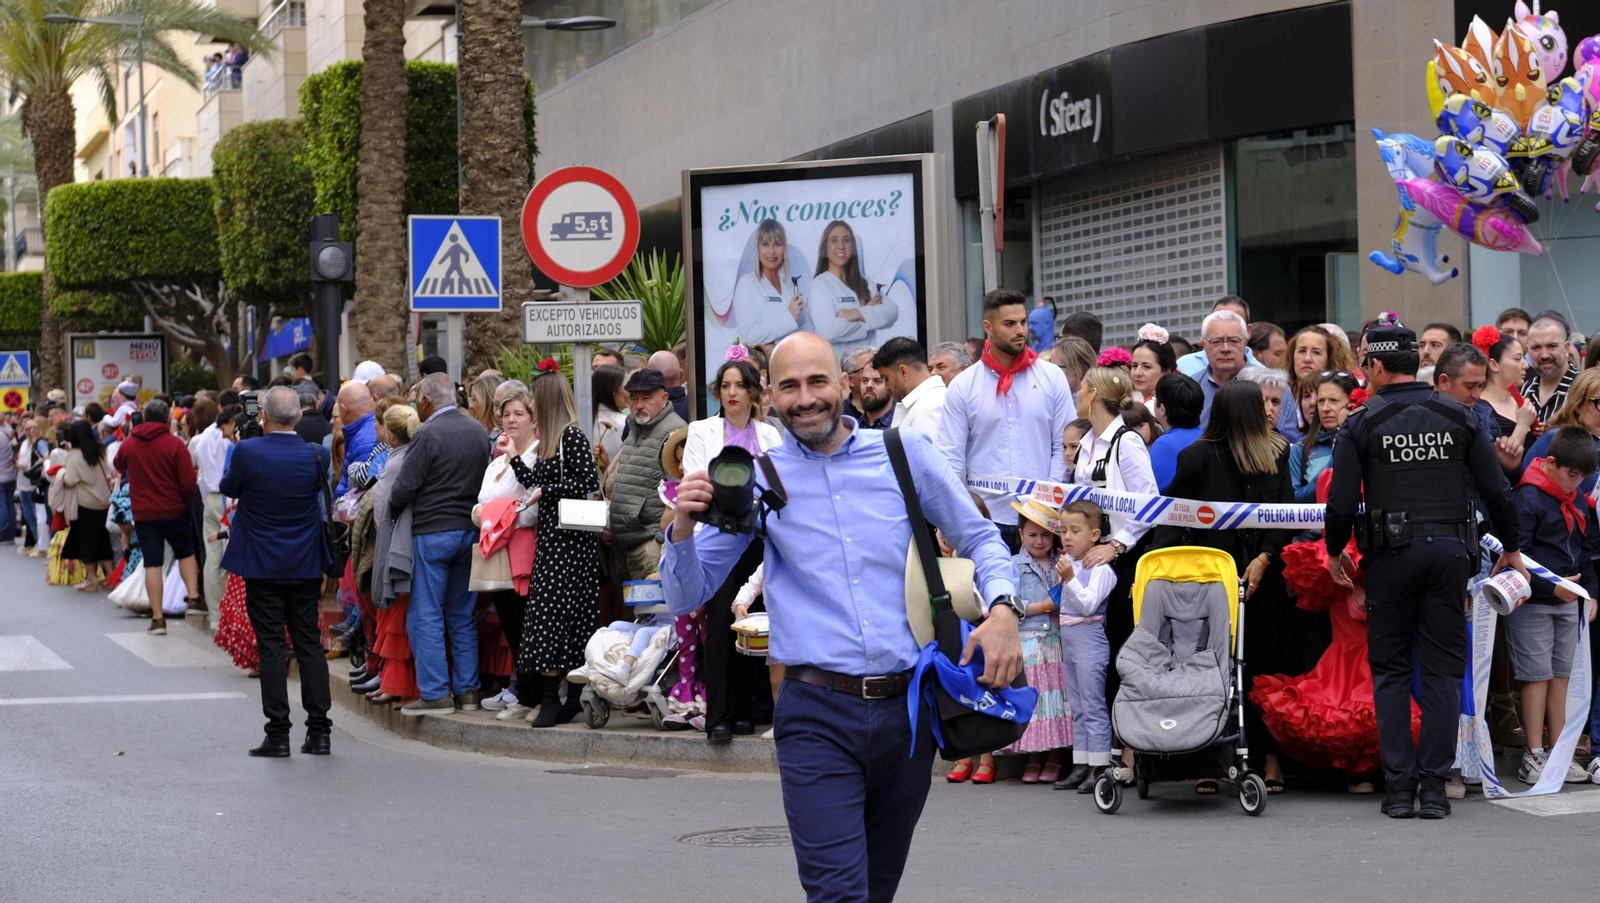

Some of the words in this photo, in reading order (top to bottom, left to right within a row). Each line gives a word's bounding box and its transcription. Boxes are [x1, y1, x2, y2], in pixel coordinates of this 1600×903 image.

[718, 199, 779, 232] ¿Nos
[786, 190, 903, 222] conoces?
[574, 215, 608, 233] 5,5t
[529, 308, 576, 322] EXCEPTO
[579, 307, 638, 320] VEHICULOS
[546, 323, 622, 337] AUTORIZADOS
[130, 339, 158, 349] MENÚ
[1382, 432, 1454, 449] POLICIA
[1390, 446, 1449, 463] LOCAL
[1115, 496, 1136, 514] LOCAL
[1257, 508, 1295, 523] POLICIA
